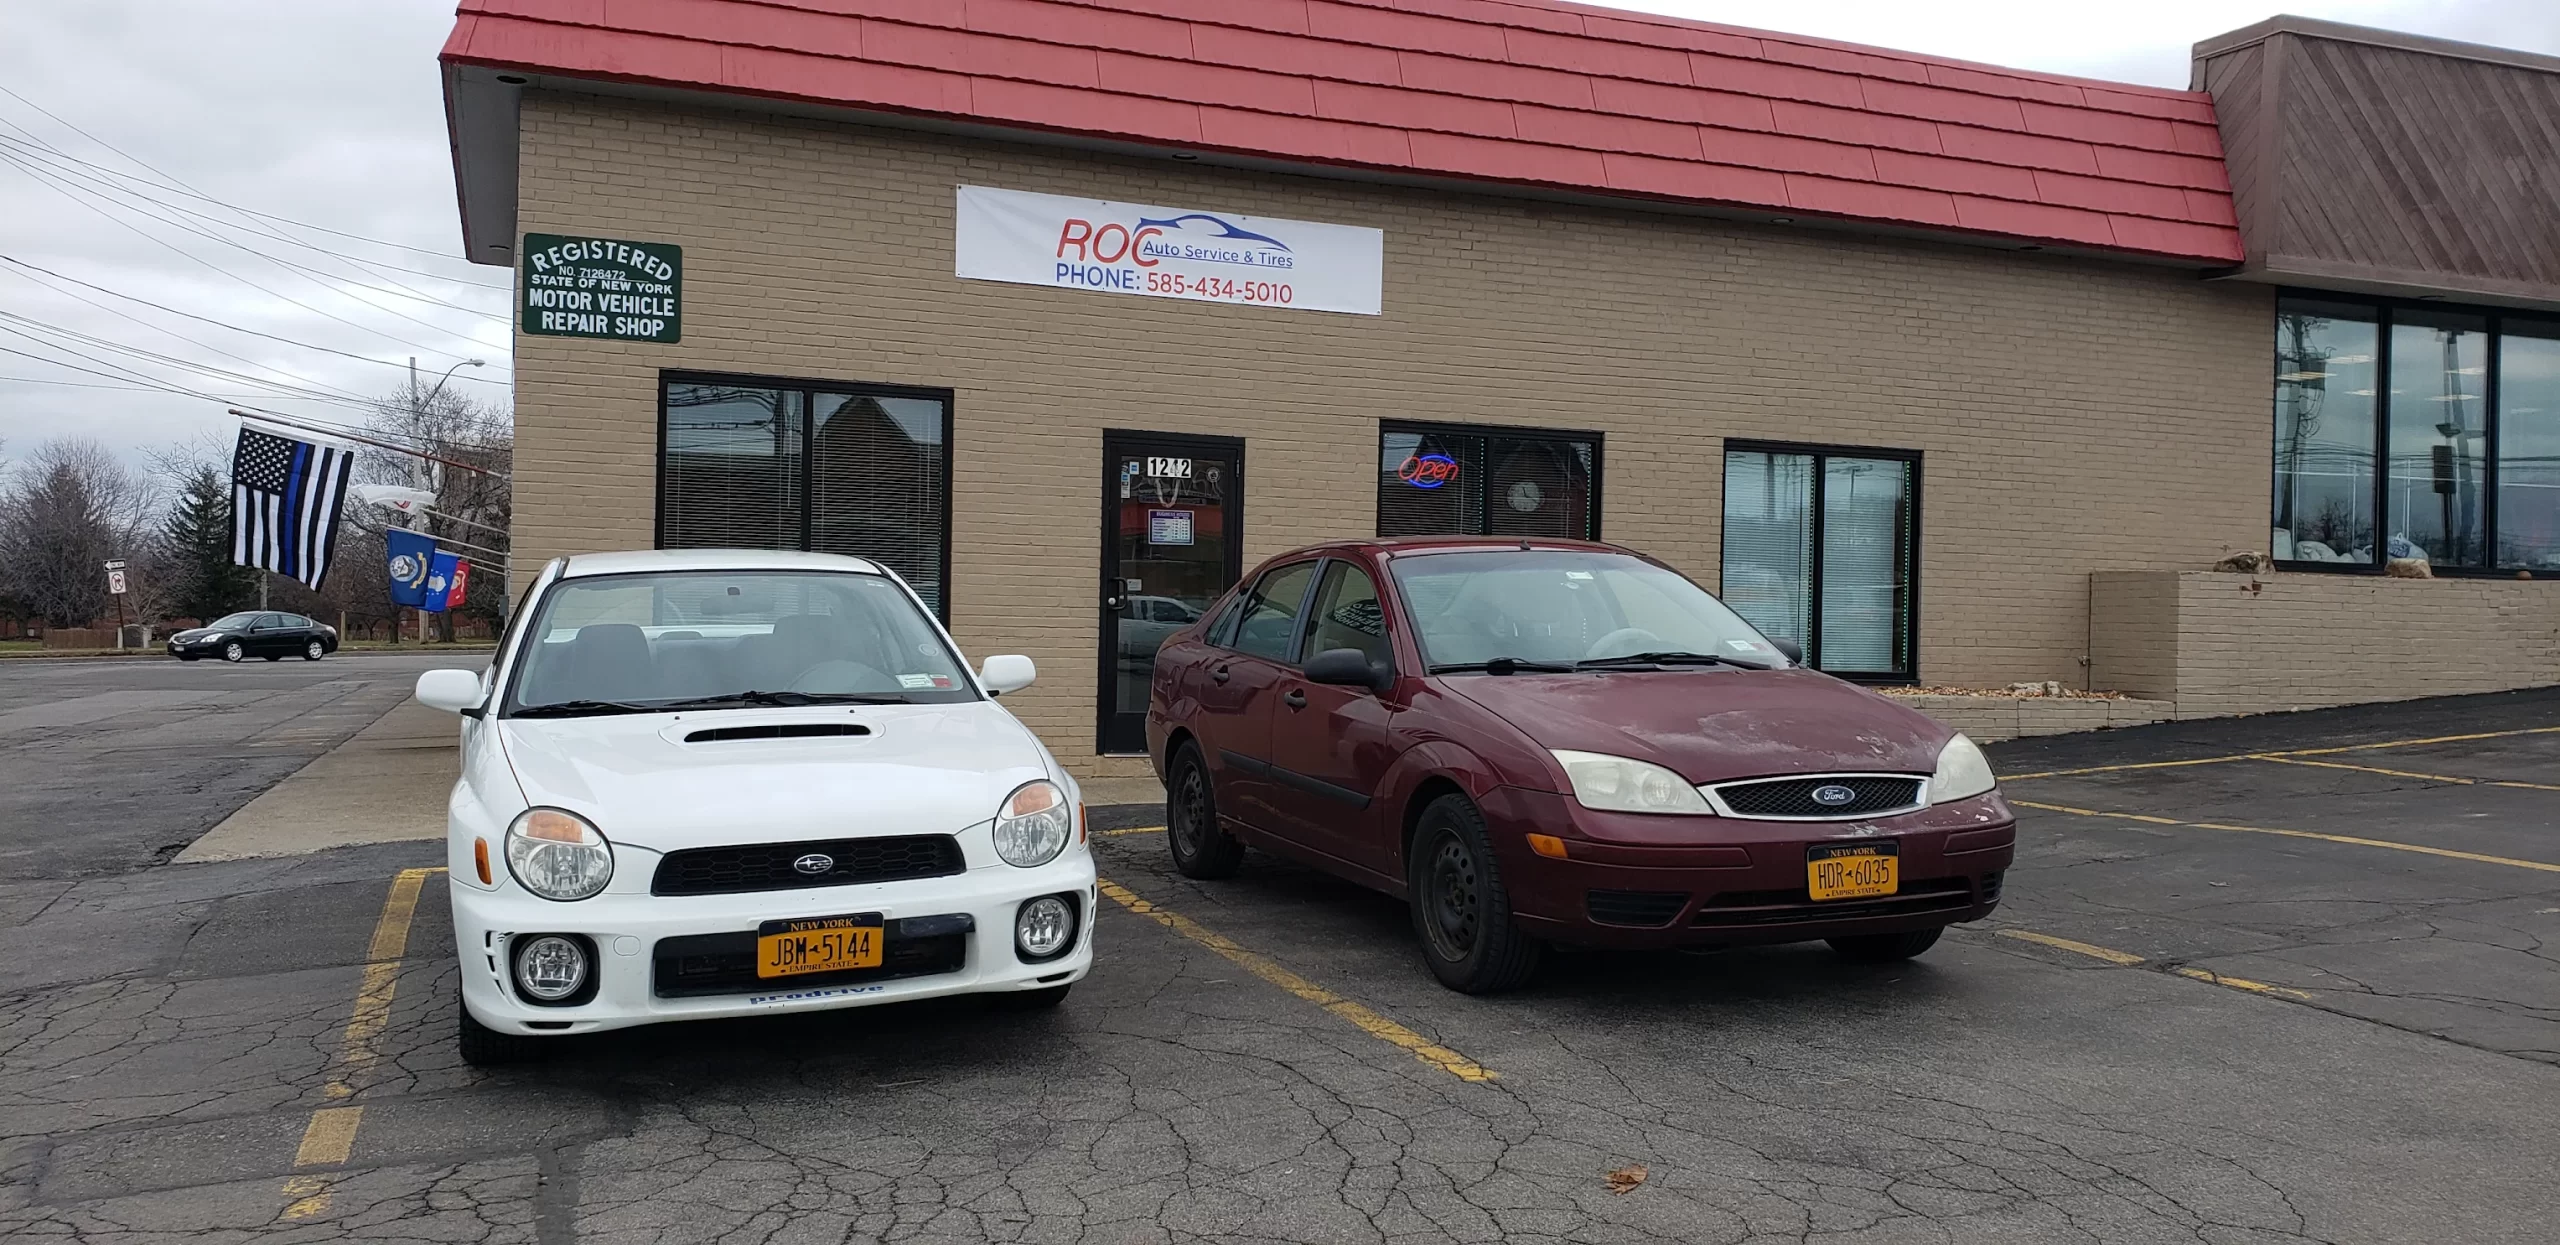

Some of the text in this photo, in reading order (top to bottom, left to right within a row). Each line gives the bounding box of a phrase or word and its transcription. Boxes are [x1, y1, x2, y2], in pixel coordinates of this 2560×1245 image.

[1056, 218, 1163, 267] ROC
[531, 240, 673, 281] REGISTERED
[1143, 240, 1293, 267] Auto Service & Tires
[559, 265, 626, 281] NO. 7126472
[1056, 262, 1293, 304] PHONE: 585-434-5010
[531, 274, 673, 295] STATE OF NEW YORK
[529, 288, 675, 317] MOTOR VEHICLE
[542, 311, 665, 338] REPAIR SHOP
[1398, 456, 1460, 482] Open
[1824, 789, 1845, 801] Ford
[1830, 846, 1877, 858] NEW YORK
[1831, 887, 1876, 897] EMPIRE STATE
[790, 918, 854, 932] NEW YORK
[789, 960, 853, 973] EMPIRE STATE
[750, 986, 884, 1004] prodrive
